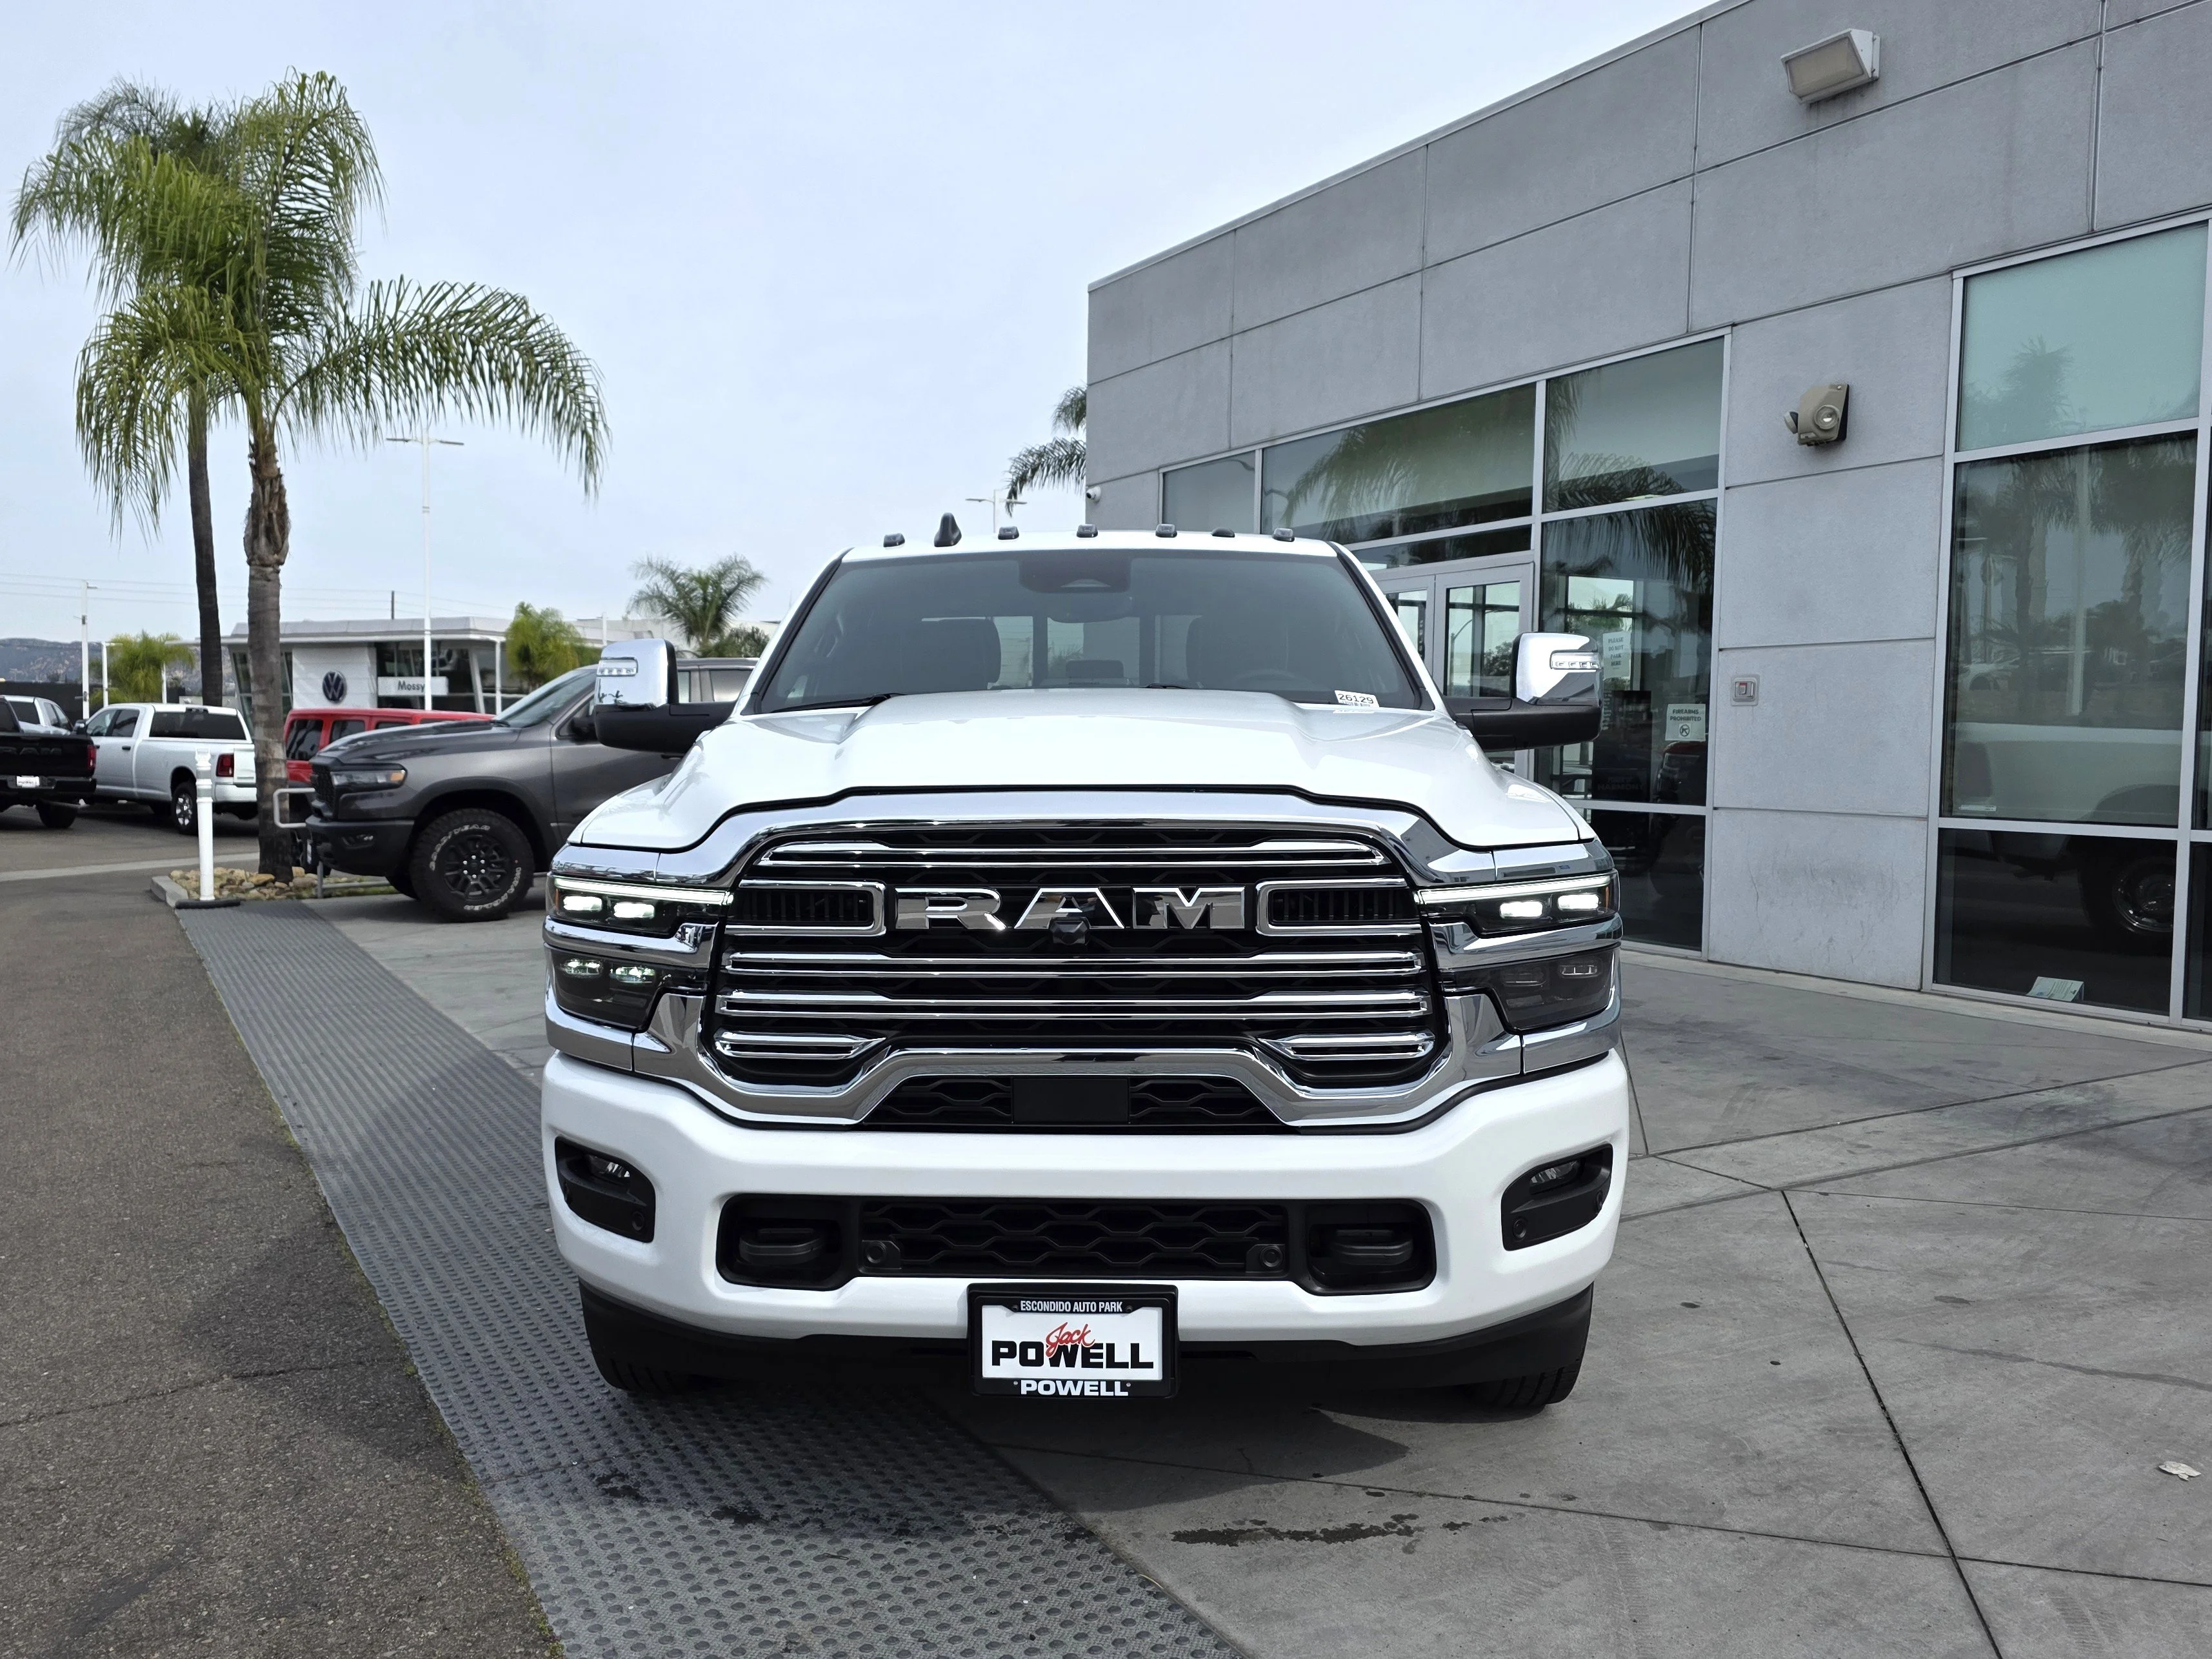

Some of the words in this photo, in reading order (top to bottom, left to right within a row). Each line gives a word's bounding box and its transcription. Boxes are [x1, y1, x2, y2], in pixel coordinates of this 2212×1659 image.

[398, 680, 426, 692] Mossy
[1338, 693, 1374, 704] 26129
[895, 887, 1245, 929] RAM
[1020, 1300, 1071, 1312] ESCONDIDO
[1072, 1301, 1097, 1312] AUTO
[1099, 1302, 1123, 1312] PARK
[1045, 1321, 1095, 1358] Jack
[991, 1340, 1154, 1369] POWELL
[1020, 1380, 1129, 1396] POWELL
